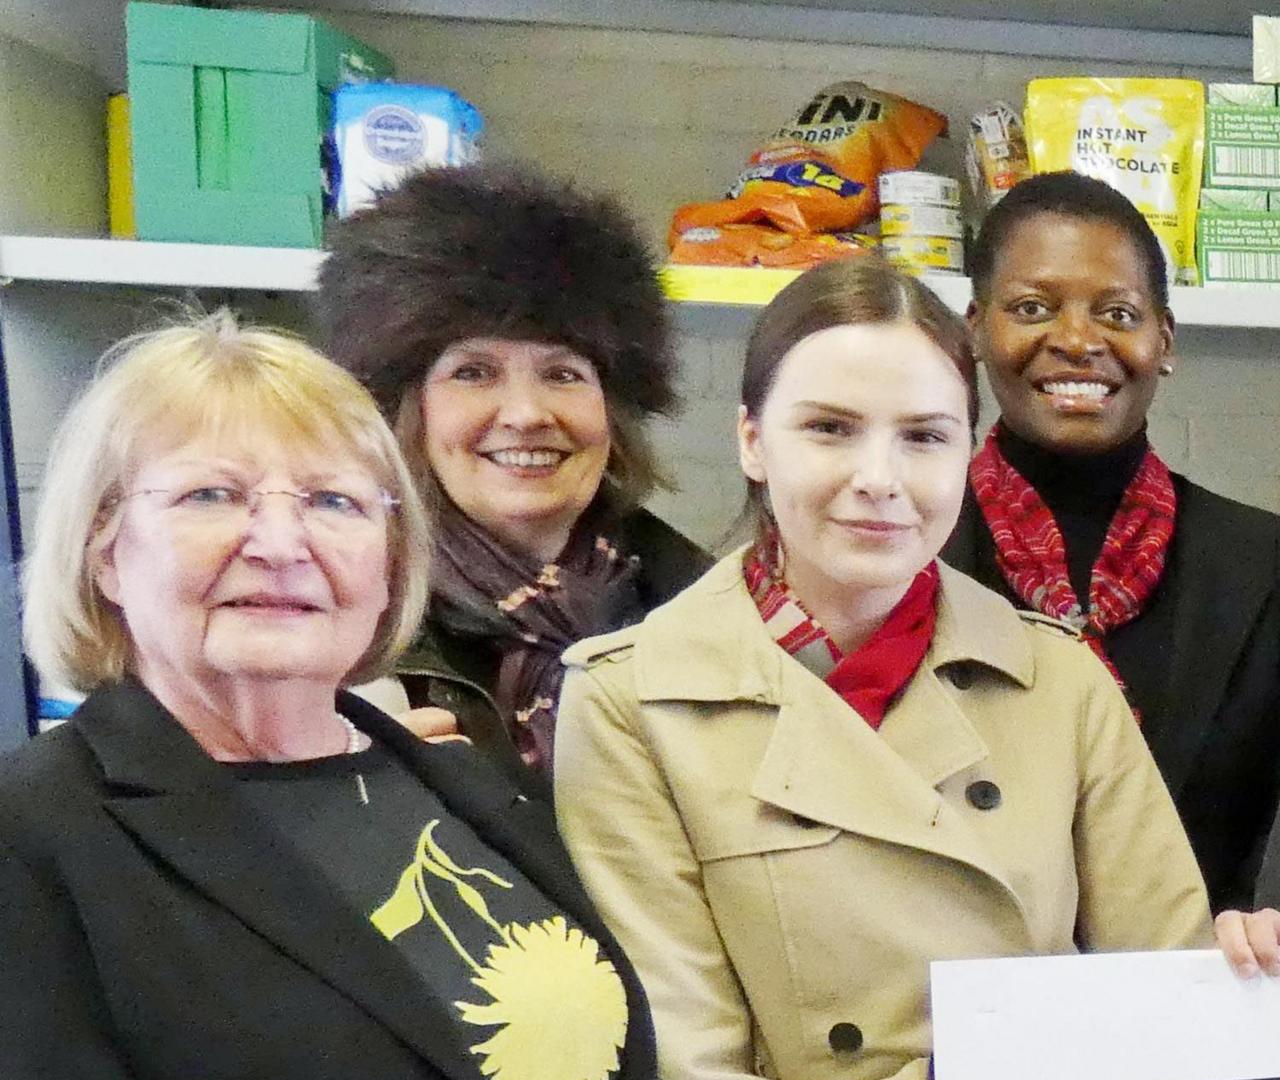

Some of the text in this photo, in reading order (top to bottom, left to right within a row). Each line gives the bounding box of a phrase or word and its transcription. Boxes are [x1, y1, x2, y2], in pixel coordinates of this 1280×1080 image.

[792, 93, 882, 126] INI
[1244, 114, 1269, 124] Green
[1249, 123, 1274, 133] Green
[1077, 128, 1148, 143] INSTANT
[1253, 132, 1279, 142] Green
[1237, 219, 1261, 229] Green
[1242, 228, 1266, 238] Green
[1246, 237, 1271, 247] Green
